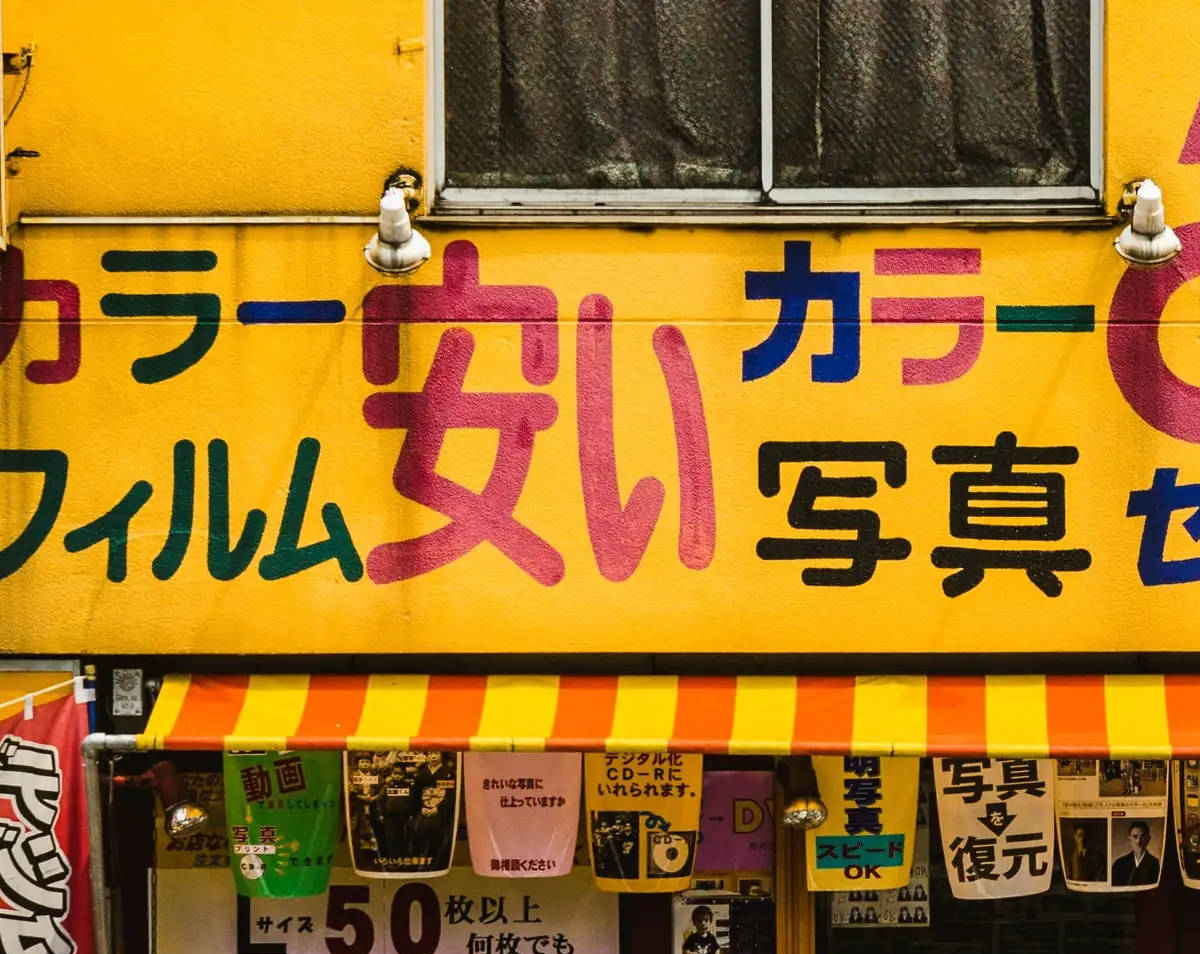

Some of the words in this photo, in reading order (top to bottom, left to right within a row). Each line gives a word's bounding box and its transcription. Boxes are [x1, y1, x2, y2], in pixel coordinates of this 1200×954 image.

[742, 241, 1095, 385] カラー
[362, 240, 716, 587] 安い
[756, 431, 1092, 597] 写真
[941, 758, 1047, 804] 写真
[816, 841, 905, 861] スピード
[844, 865, 882, 880] OK
[950, 832, 1050, 883] 復元
